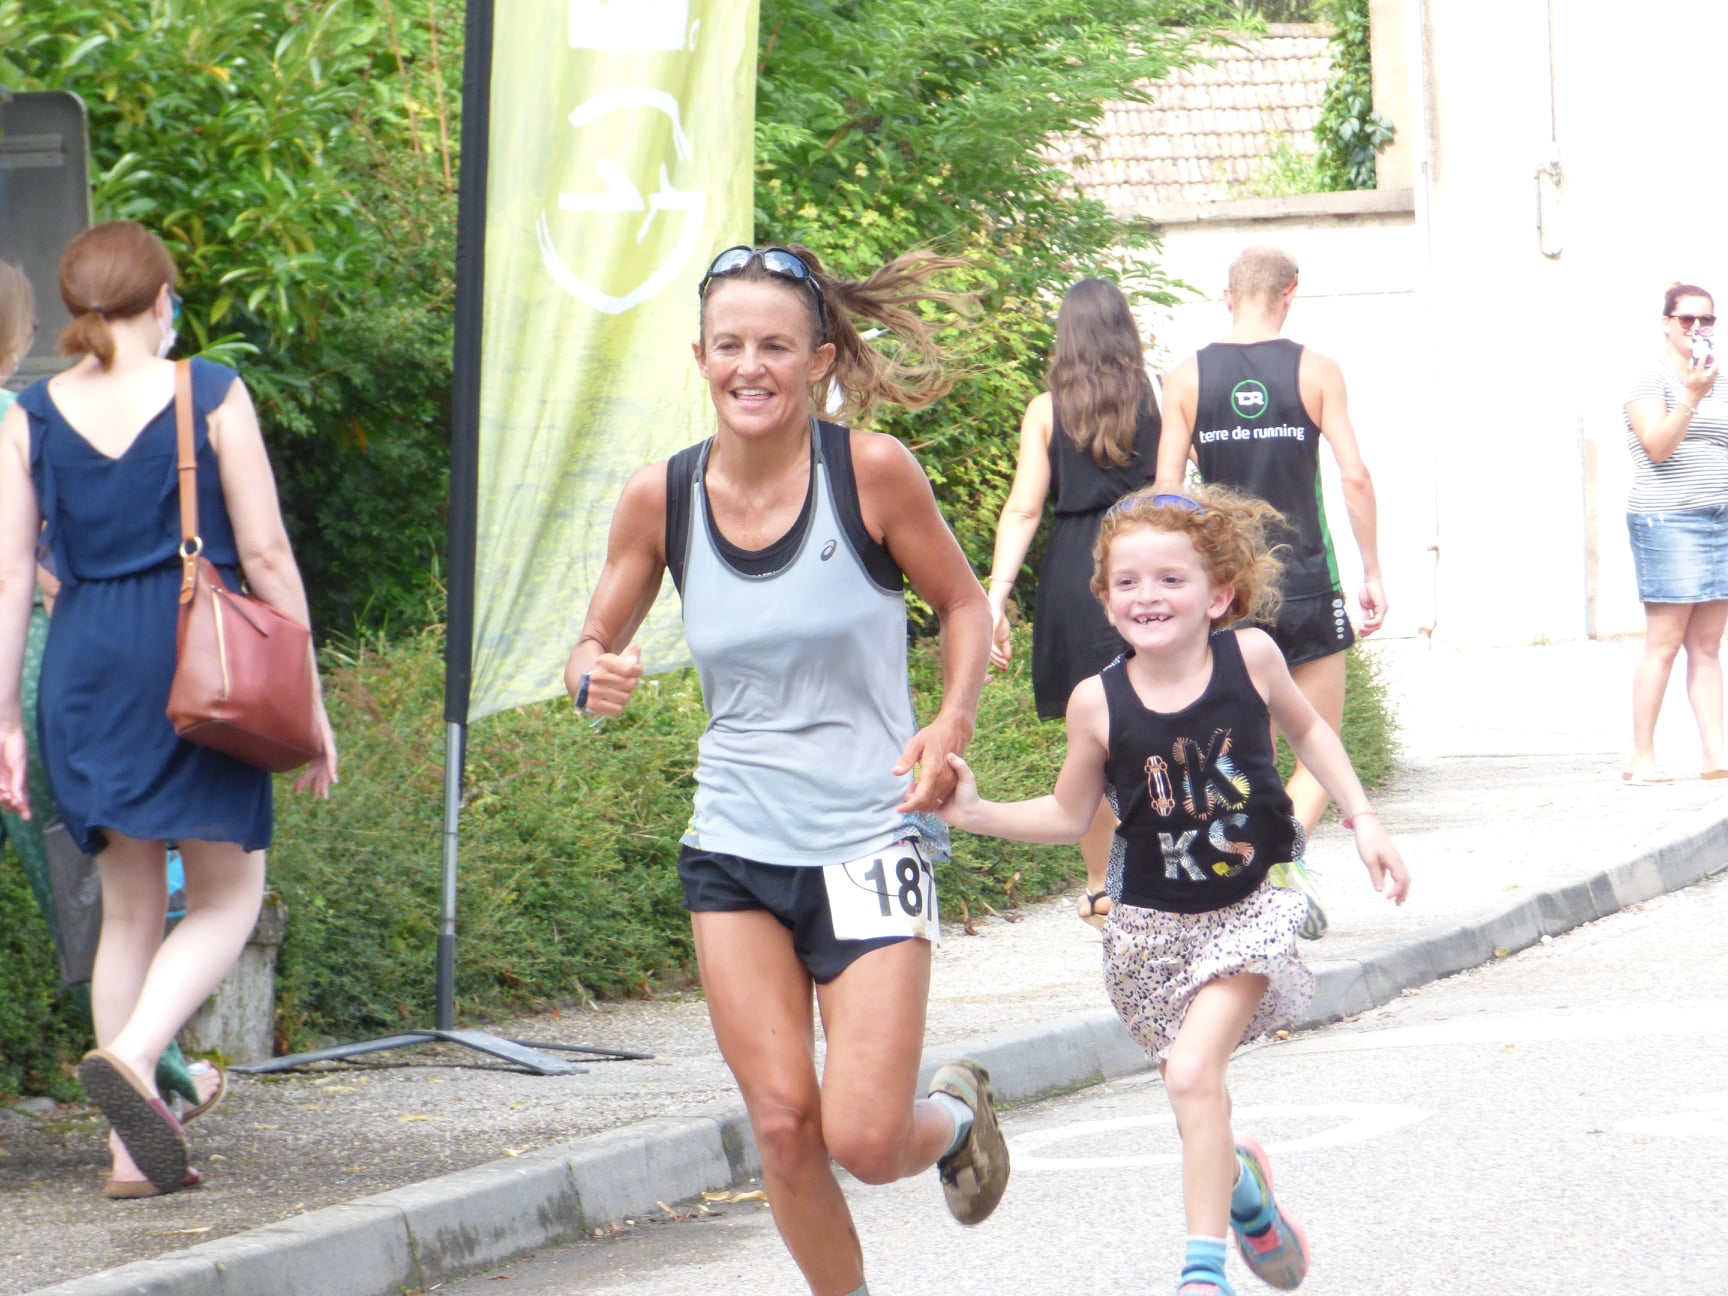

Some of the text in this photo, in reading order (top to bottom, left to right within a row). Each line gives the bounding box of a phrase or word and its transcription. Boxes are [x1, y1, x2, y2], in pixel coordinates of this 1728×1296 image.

[1199, 423, 1304, 443] terre de running
[1157, 813, 1255, 881] KS
